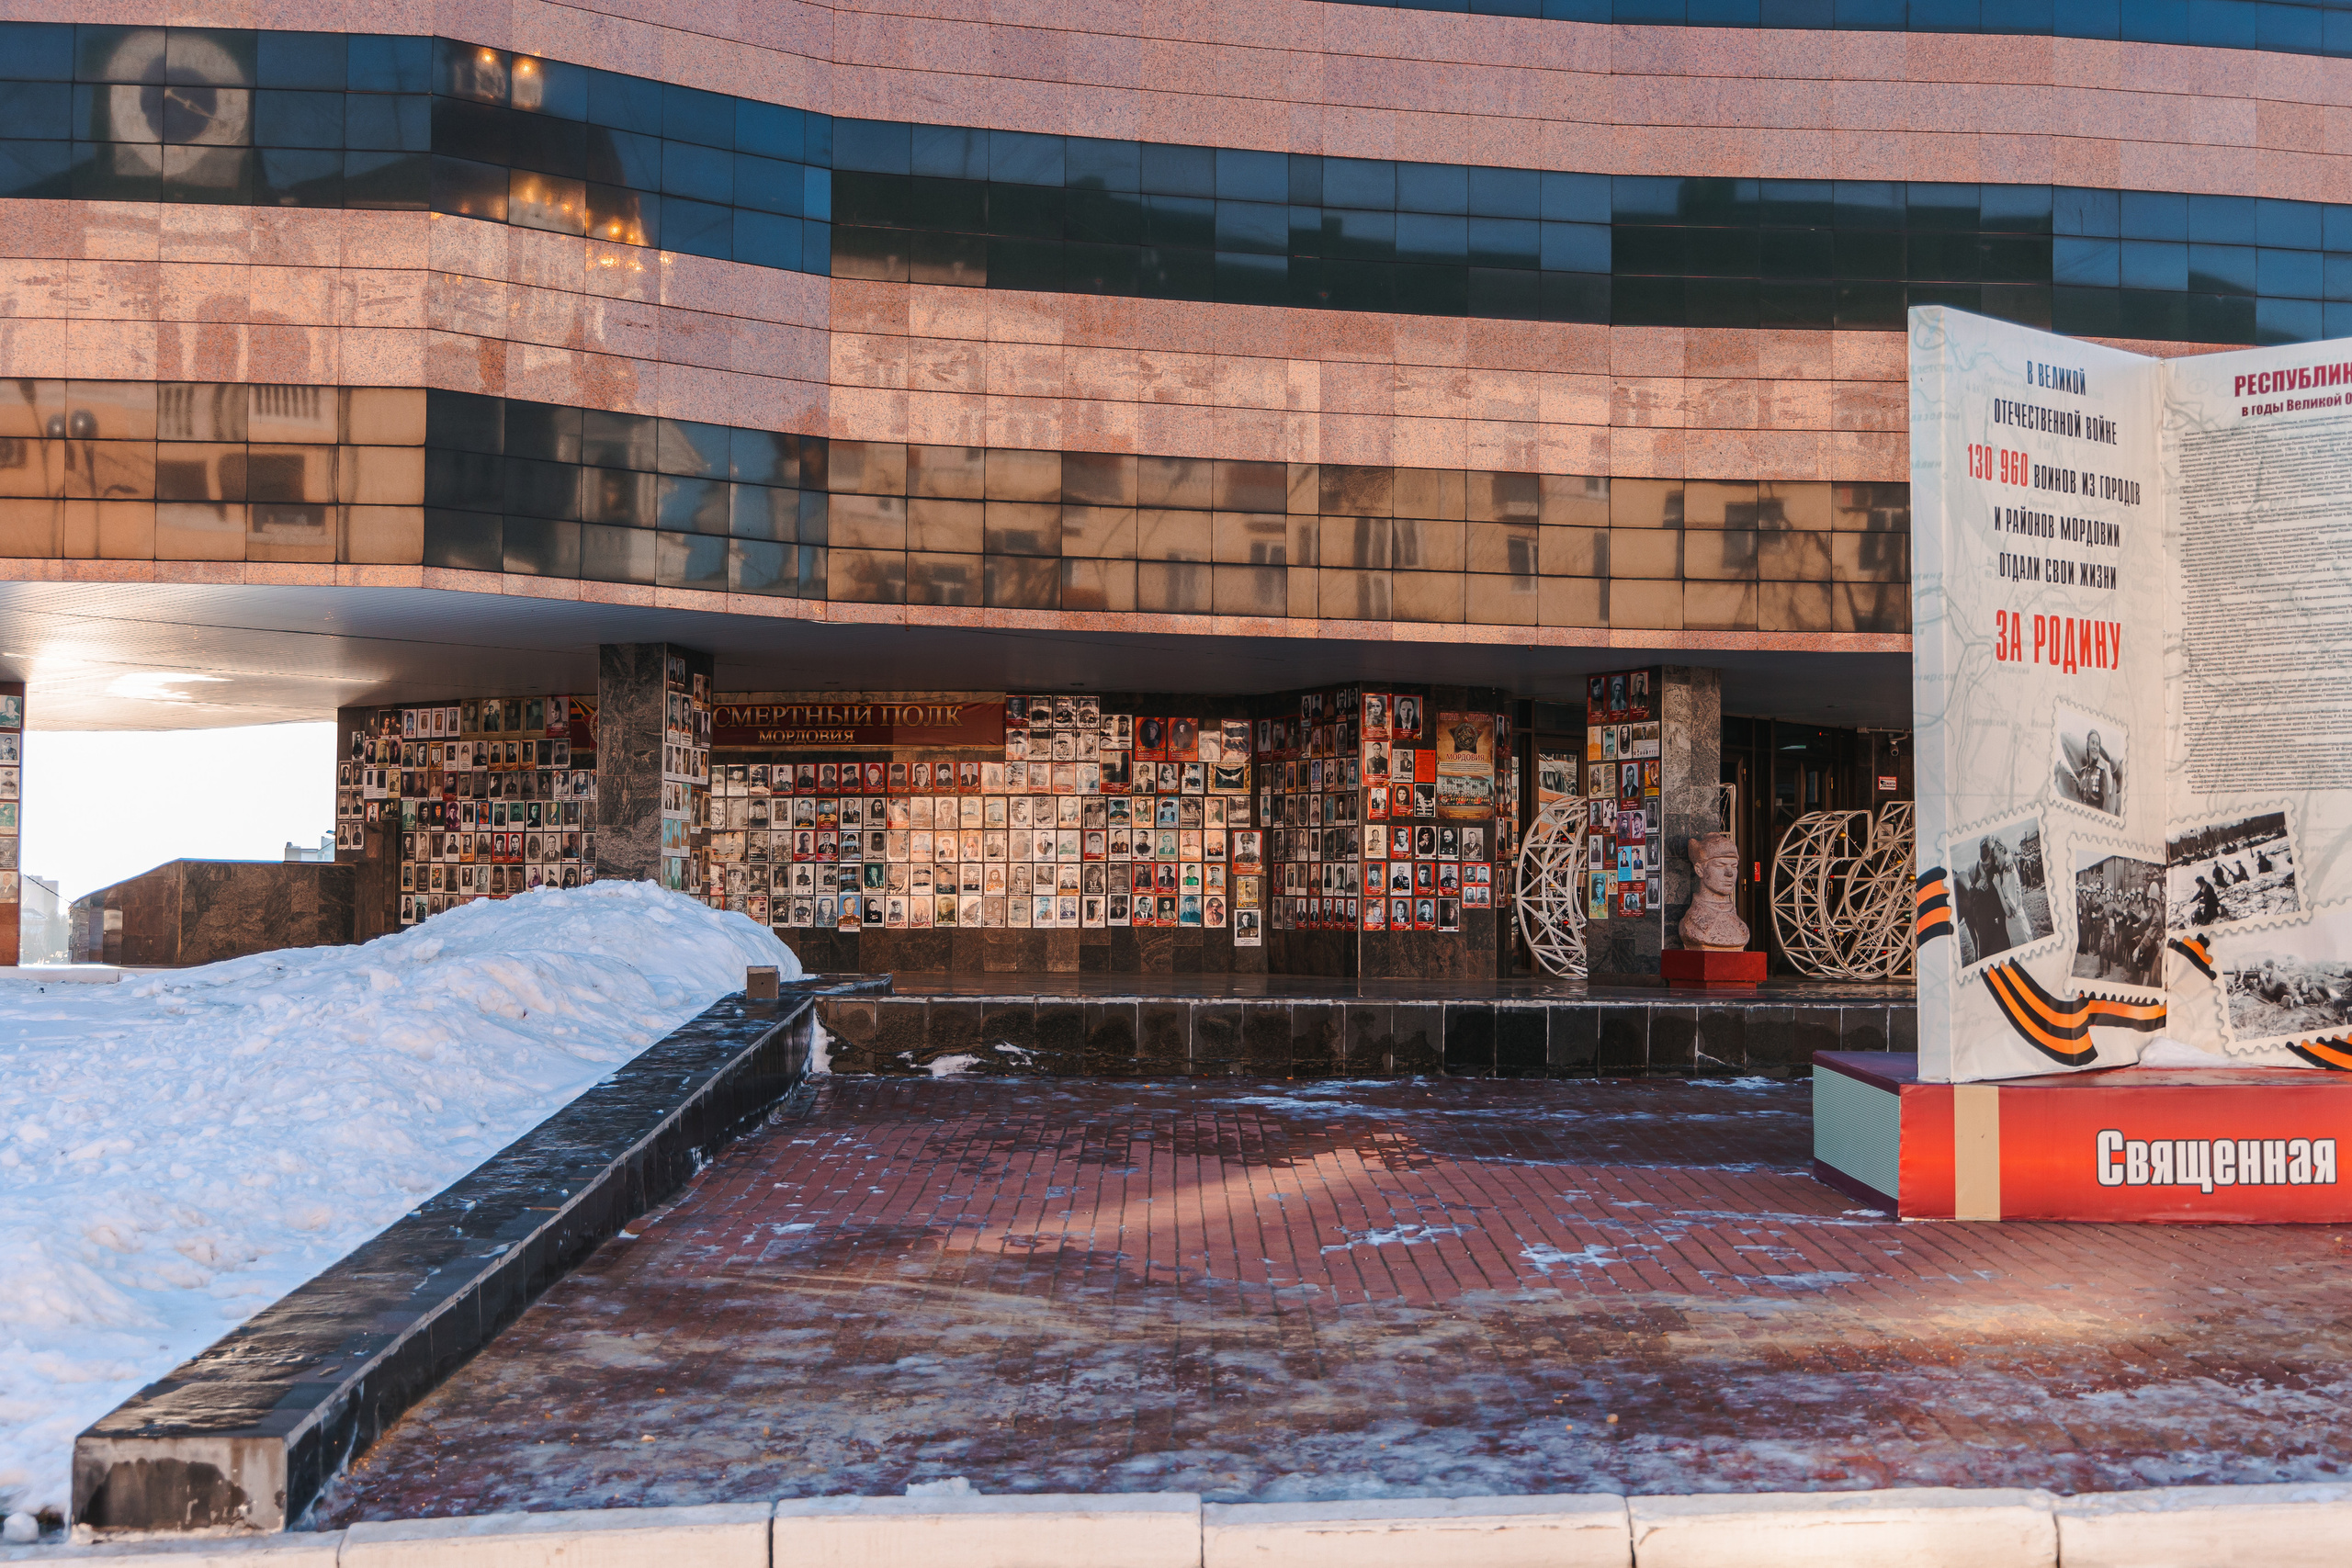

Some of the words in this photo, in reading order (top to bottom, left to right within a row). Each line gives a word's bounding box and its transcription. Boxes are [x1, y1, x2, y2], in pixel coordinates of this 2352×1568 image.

[2027, 360, 2033, 385] В
[2038, 363, 2086, 396] ВЕЛИКОЙ
[1994, 398, 2081, 438] ОТЕЧЕСТВЕННОЙ
[2086, 414, 2118, 446] ВОЙНЕ
[2242, 407, 2248, 416] в
[2251, 402, 2283, 415] годы
[2287, 392, 2342, 412] Великой
[1967, 443, 1993, 481] 130
[2000, 448, 2029, 488] 960
[2034, 464, 2076, 494] ВОИНОВ
[2082, 471, 2096, 498] ИЗ
[2099, 474, 2141, 507] ГОРОДОВ
[1995, 506, 2001, 531] И
[2006, 505, 2054, 539] РАЙОНОВ
[2060, 515, 2120, 547] МОРДОВИИ
[1999, 552, 2040, 582] ОТДАЛИ
[2045, 558, 2075, 585] СВОИ
[2080, 562, 2117, 590] ЖИЗНИ
[1996, 609, 2022, 662] ЗА
[2033, 614, 2120, 675] РОДИНУ
[879, 705, 964, 727] ПОЛК
[758, 729, 855, 745] МОРДОВИЯ
[1446, 753, 1485, 761] МОРДОВИЯ
[2097, 1129, 2337, 1194] Священная
